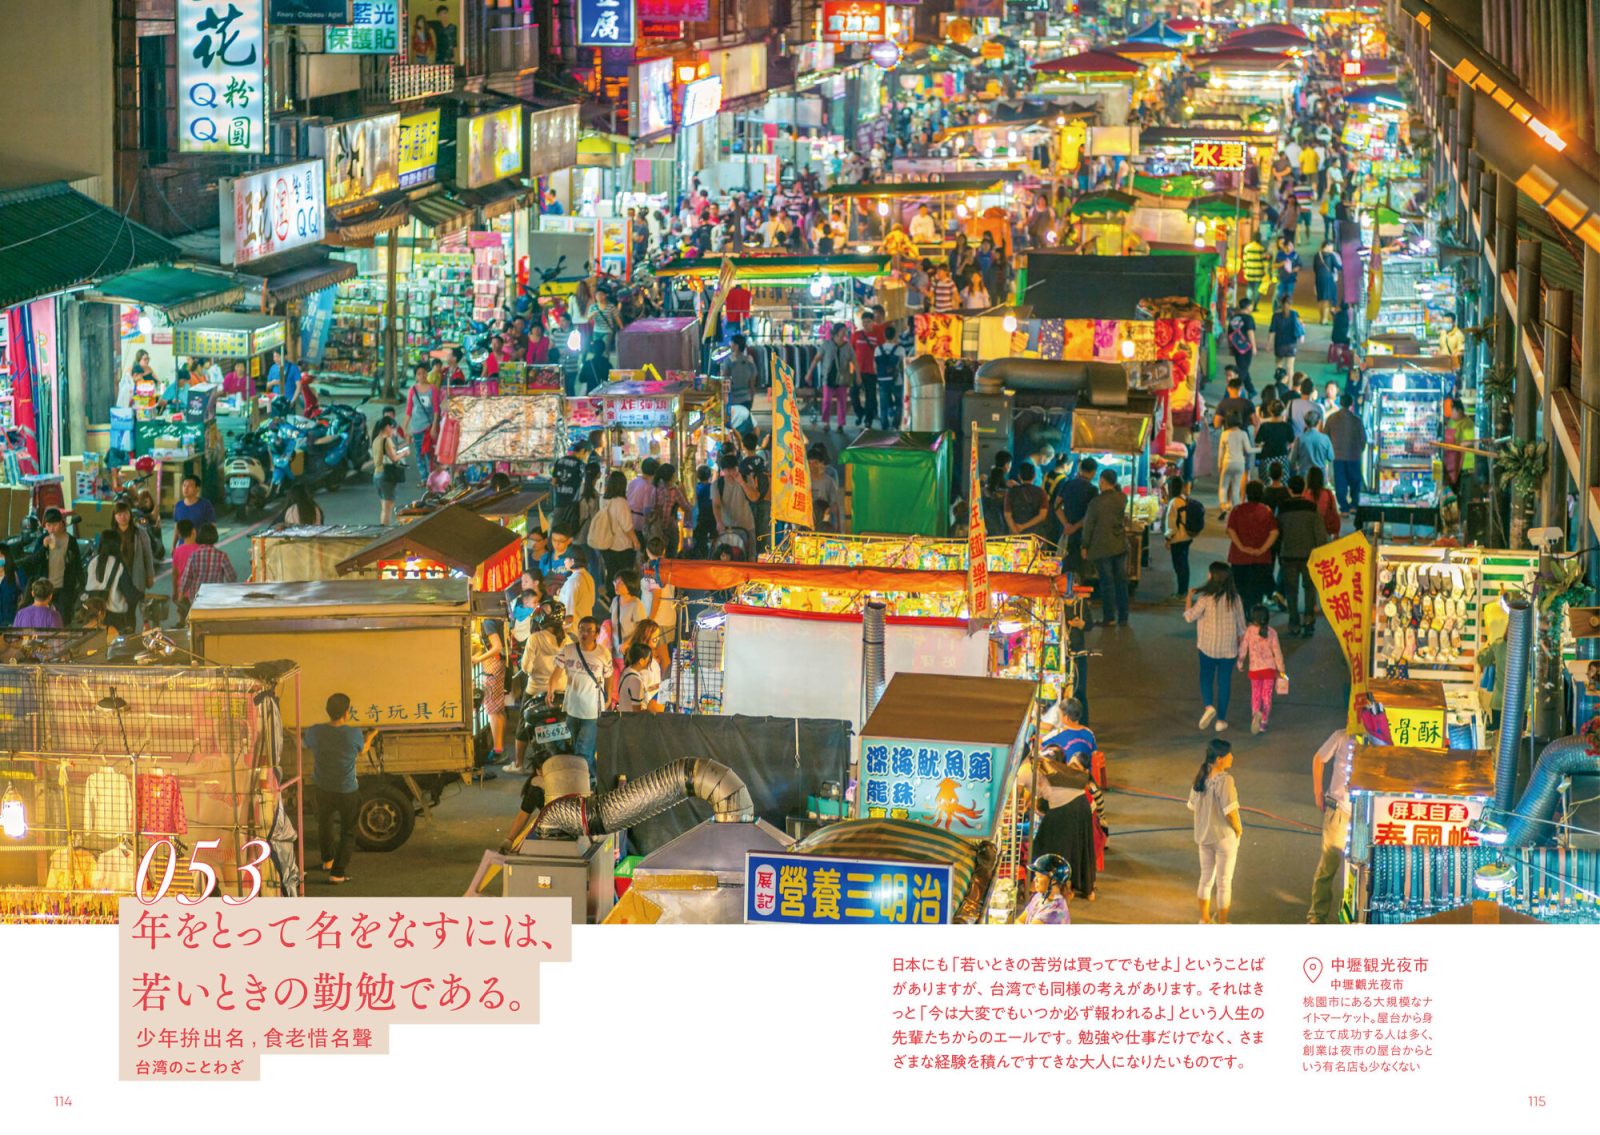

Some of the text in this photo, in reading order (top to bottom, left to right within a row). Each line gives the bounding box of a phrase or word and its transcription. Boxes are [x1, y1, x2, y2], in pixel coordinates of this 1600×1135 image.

[353, 2, 396, 25] 藍光
[192, 3, 257, 70] 花
[328, 27, 396, 50] 保護貼
[223, 75, 255, 149] 粉圓
[1193, 143, 1243, 167] 水果
[866, 745, 992, 781] 深海魷魚頭
[1392, 803, 1466, 821] 屏東自產
[756, 871, 774, 909] 展記
[778, 865, 942, 924] 營養三明治
